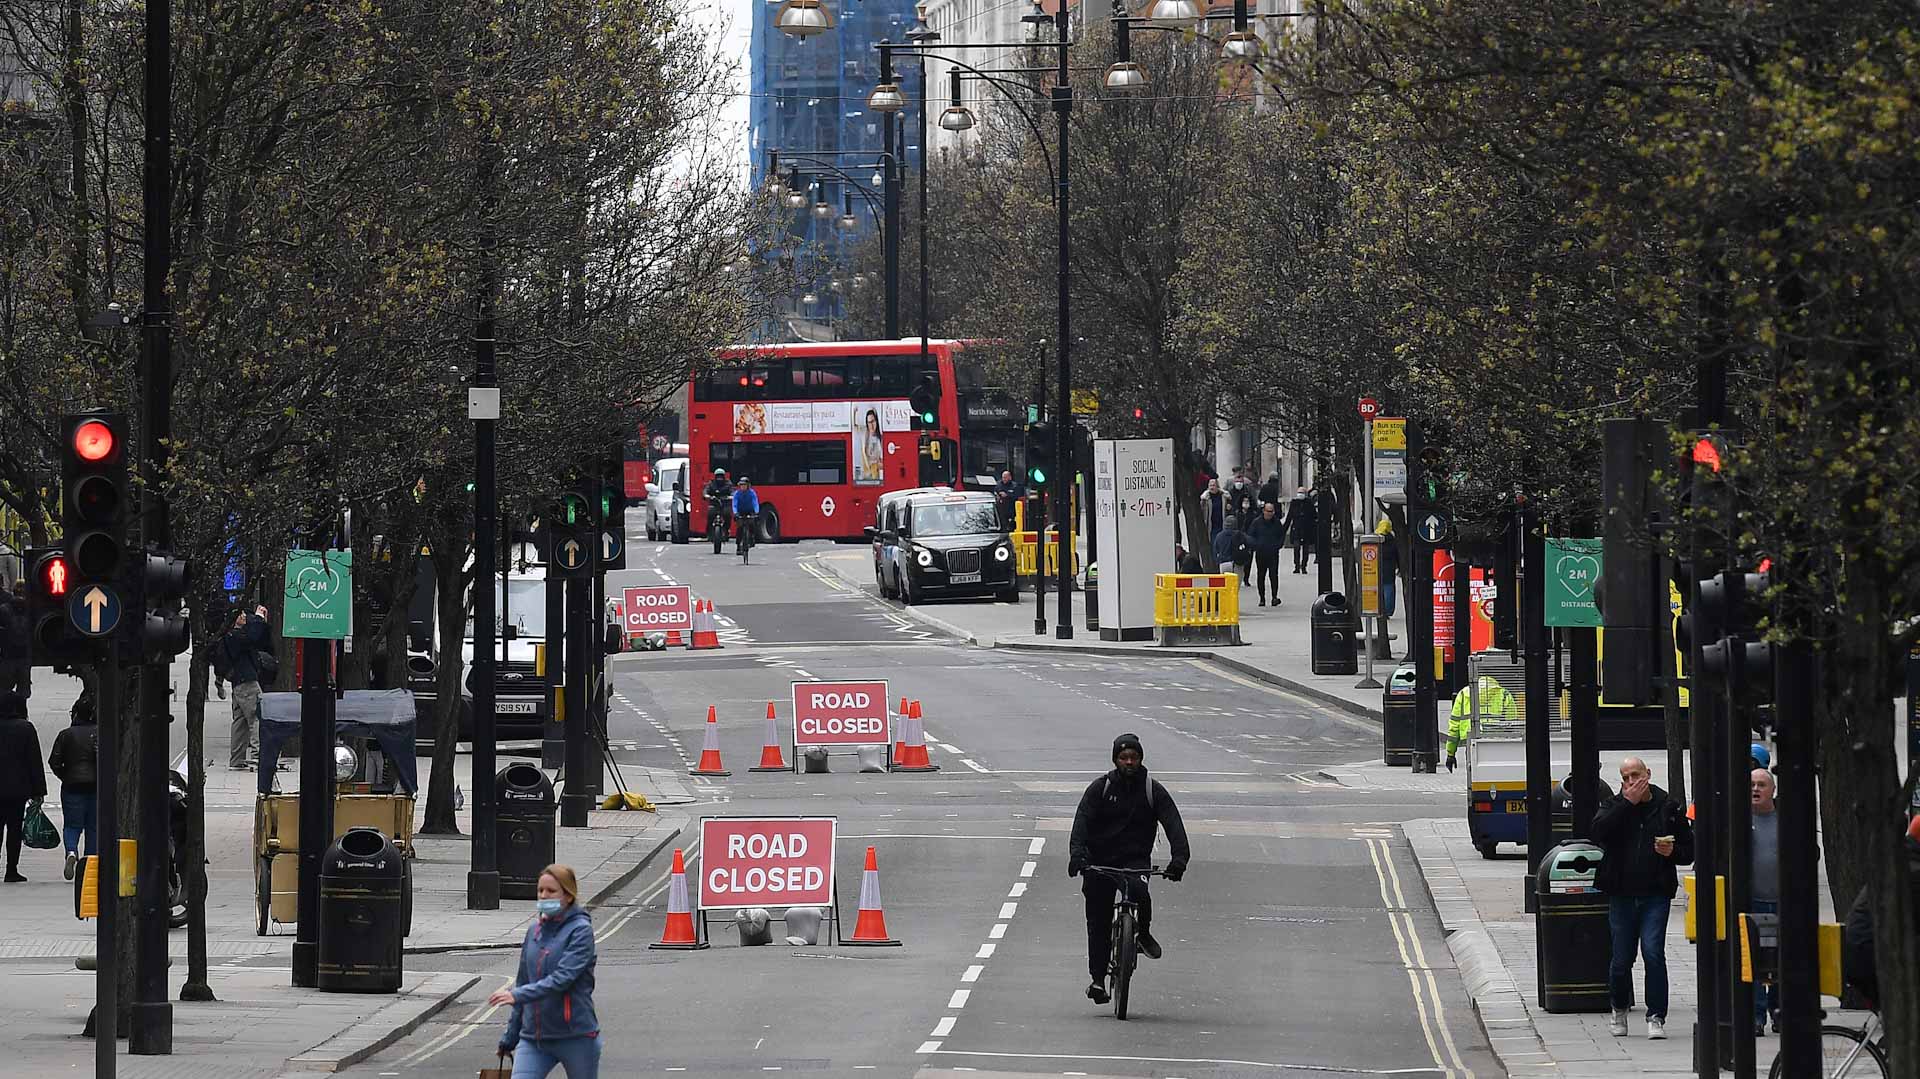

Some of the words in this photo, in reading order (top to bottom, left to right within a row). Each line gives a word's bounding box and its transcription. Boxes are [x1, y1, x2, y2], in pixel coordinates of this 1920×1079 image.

[1361, 404, 1375, 413] BD
[1132, 459, 1157, 474] SOCIAL
[1124, 475, 1166, 491] DISTANCING
[1568, 569, 1587, 579] 2M
[309, 581, 327, 591] 2M
[636, 594, 678, 606] ROAD
[1560, 600, 1595, 609] DISTANCE
[300, 611, 334, 620] DISTANCE
[629, 611, 687, 625] CLOSED
[811, 692, 871, 709] ROAD
[515, 703, 531, 712] SYA
[800, 718, 883, 735] CLOSED
[728, 833, 808, 859] ROAD
[708, 867, 824, 893] CLOSED
